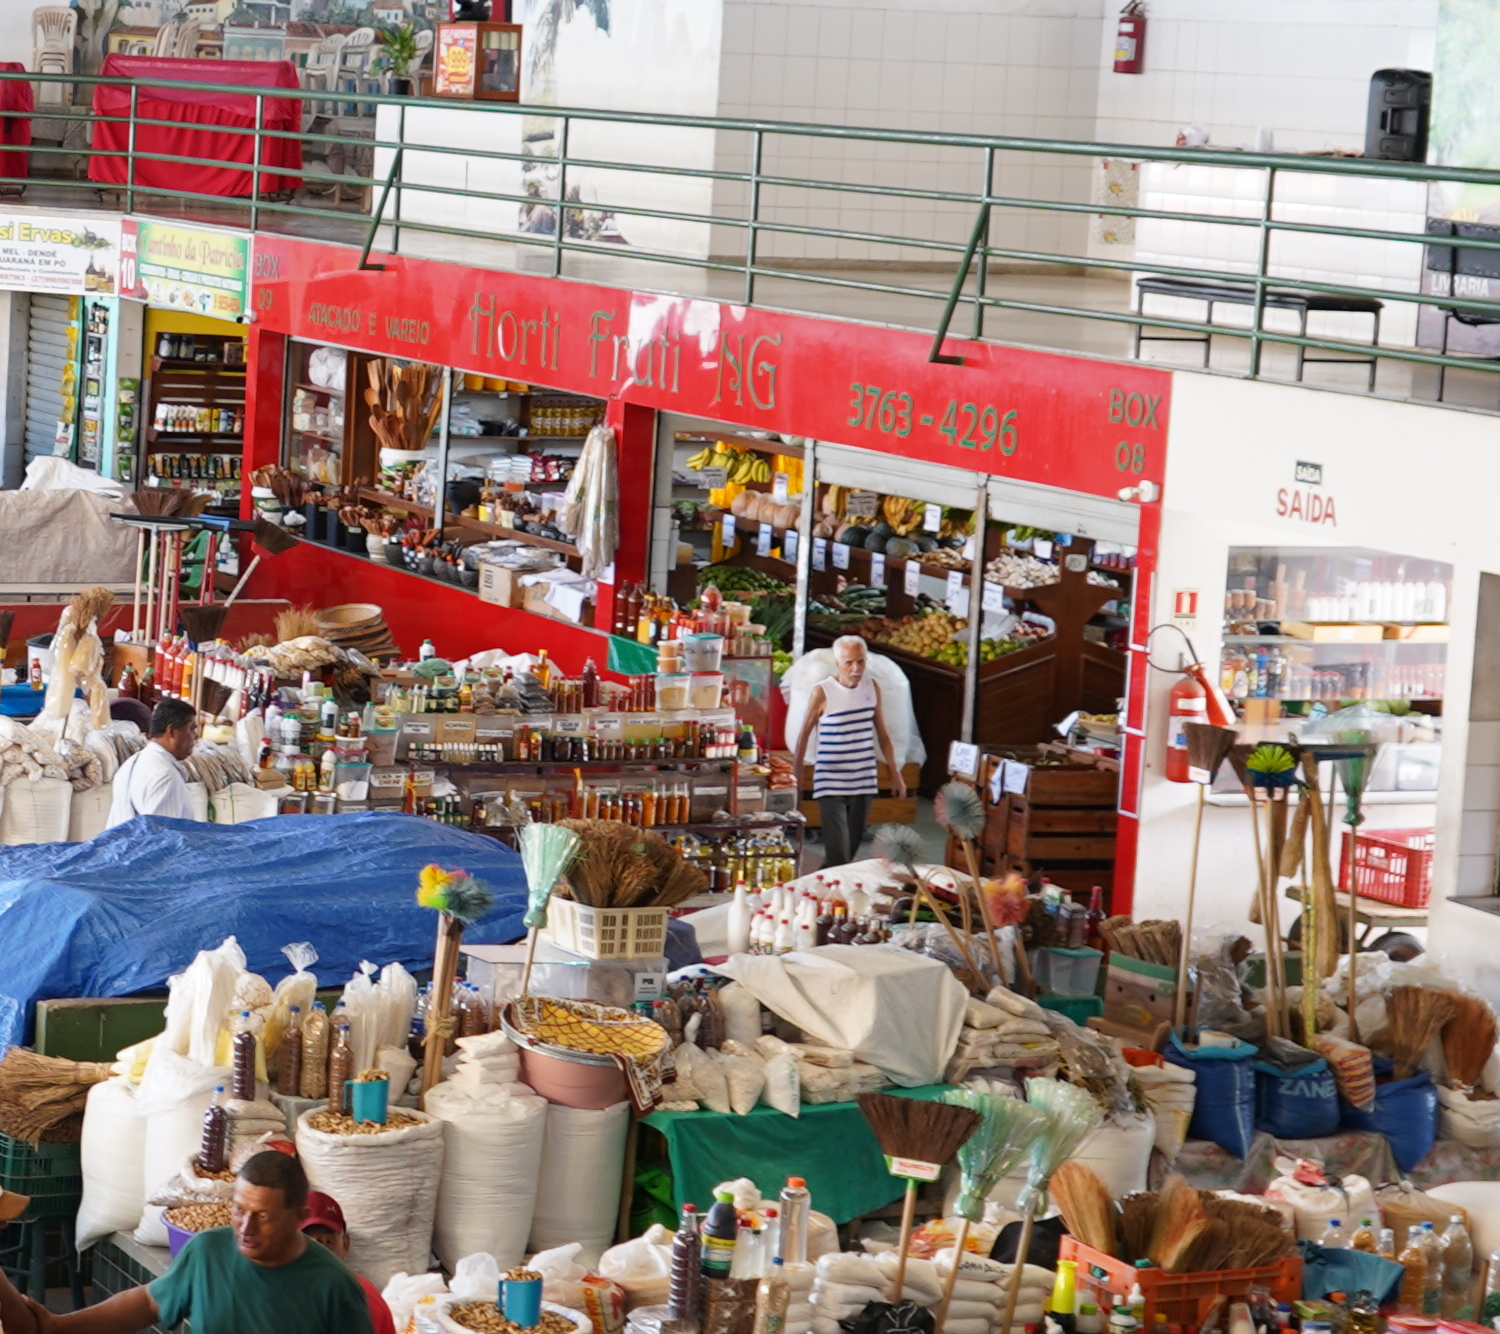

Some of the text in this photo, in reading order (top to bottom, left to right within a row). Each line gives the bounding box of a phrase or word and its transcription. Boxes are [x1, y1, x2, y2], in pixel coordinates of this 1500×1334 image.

[18, 222, 74, 244] Ervas
[2, 247, 19, 256] MEL
[38, 258, 51, 266] EM
[184, 237, 196, 261] da
[121, 256, 136, 290] 10
[254, 253, 280, 279] BOX
[258, 289, 273, 310] 09
[308, 302, 361, 332] ATACADO
[368, 313, 377, 335] E
[469, 291, 784, 410] Horti Fruti NG
[1108, 388, 1161, 430] BOX
[1115, 441, 1146, 474] 08
[1275, 485, 1337, 528] SAÍDA
